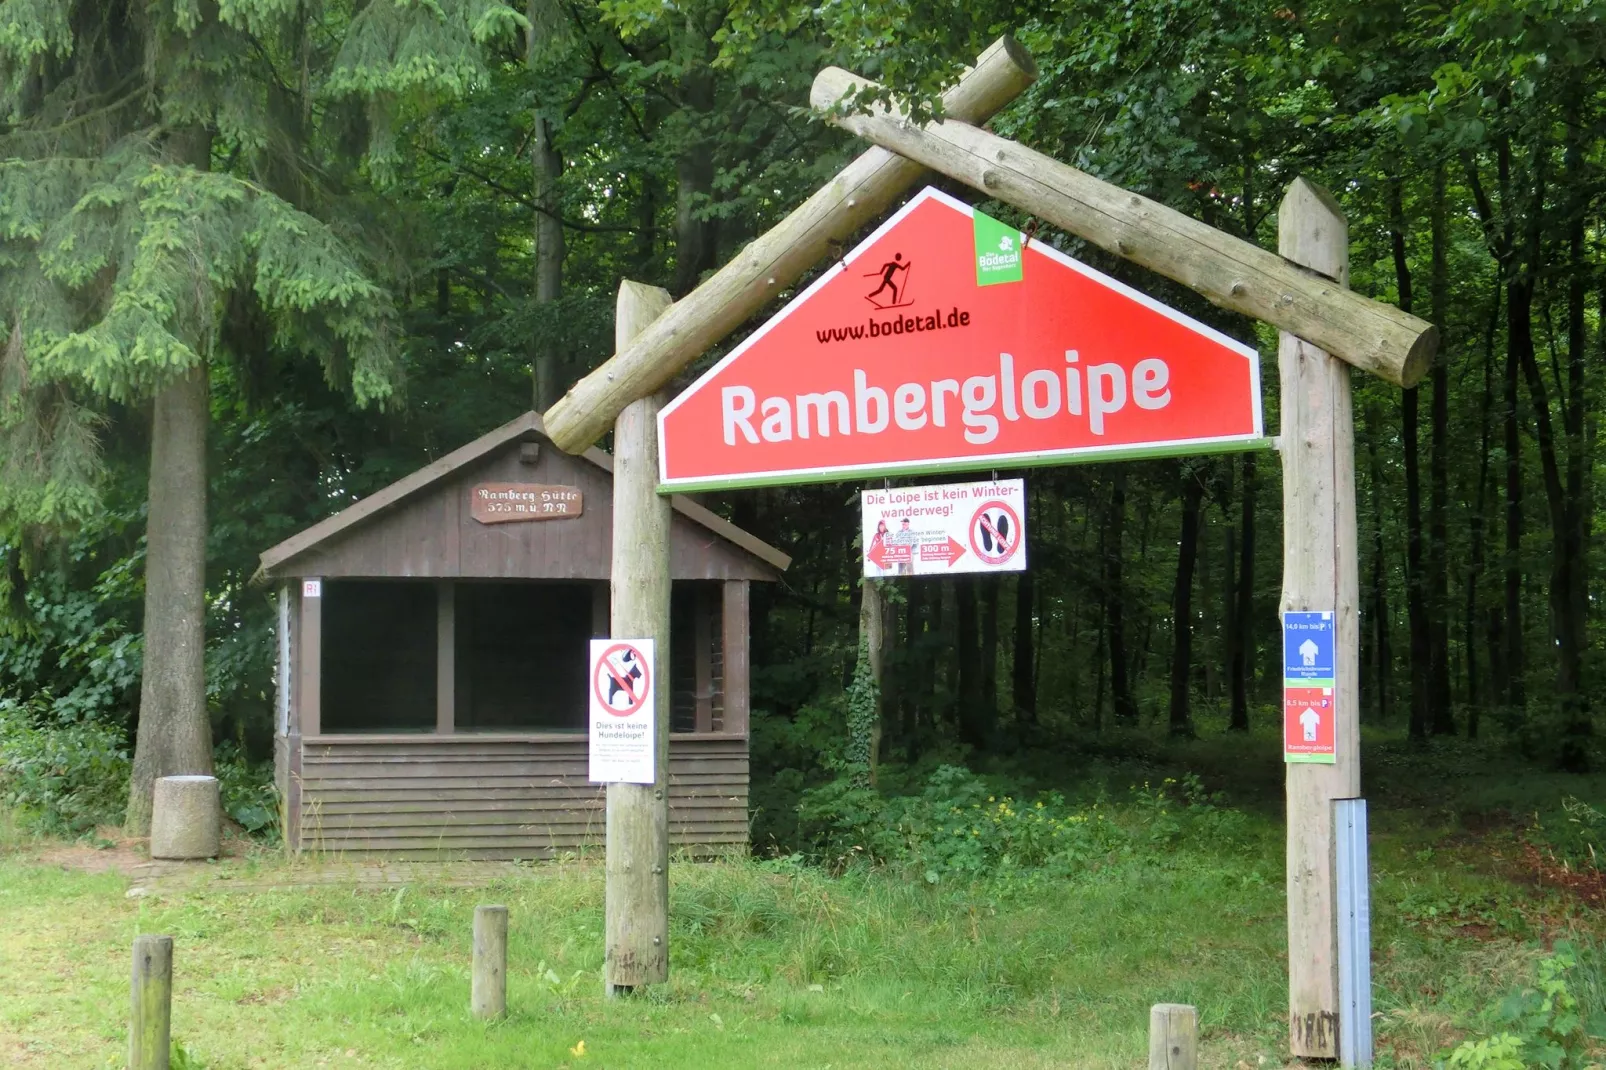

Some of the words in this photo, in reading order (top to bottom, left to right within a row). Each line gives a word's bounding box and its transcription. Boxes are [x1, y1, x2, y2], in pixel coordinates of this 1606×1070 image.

[979, 250, 1019, 267] Bodetal
[816, 306, 971, 344] www.bodetal.de
[721, 348, 1171, 447] Rambergloipe
[478, 488, 535, 502] Ramberg
[540, 490, 578, 502] Hütte
[867, 494, 885, 505] Die
[889, 491, 921, 504] Loipe
[924, 490, 939, 501] ist
[943, 489, 968, 500] kein
[972, 486, 1019, 498] Winter-
[487, 502, 512, 513] 575
[881, 503, 954, 518] wanderweg!
[885, 547, 895, 555] 75
[596, 721, 613, 730] Dies
[615, 722, 625, 730] ist
[627, 722, 648, 730] keine
[598, 731, 645, 740] Hundeloipe!
